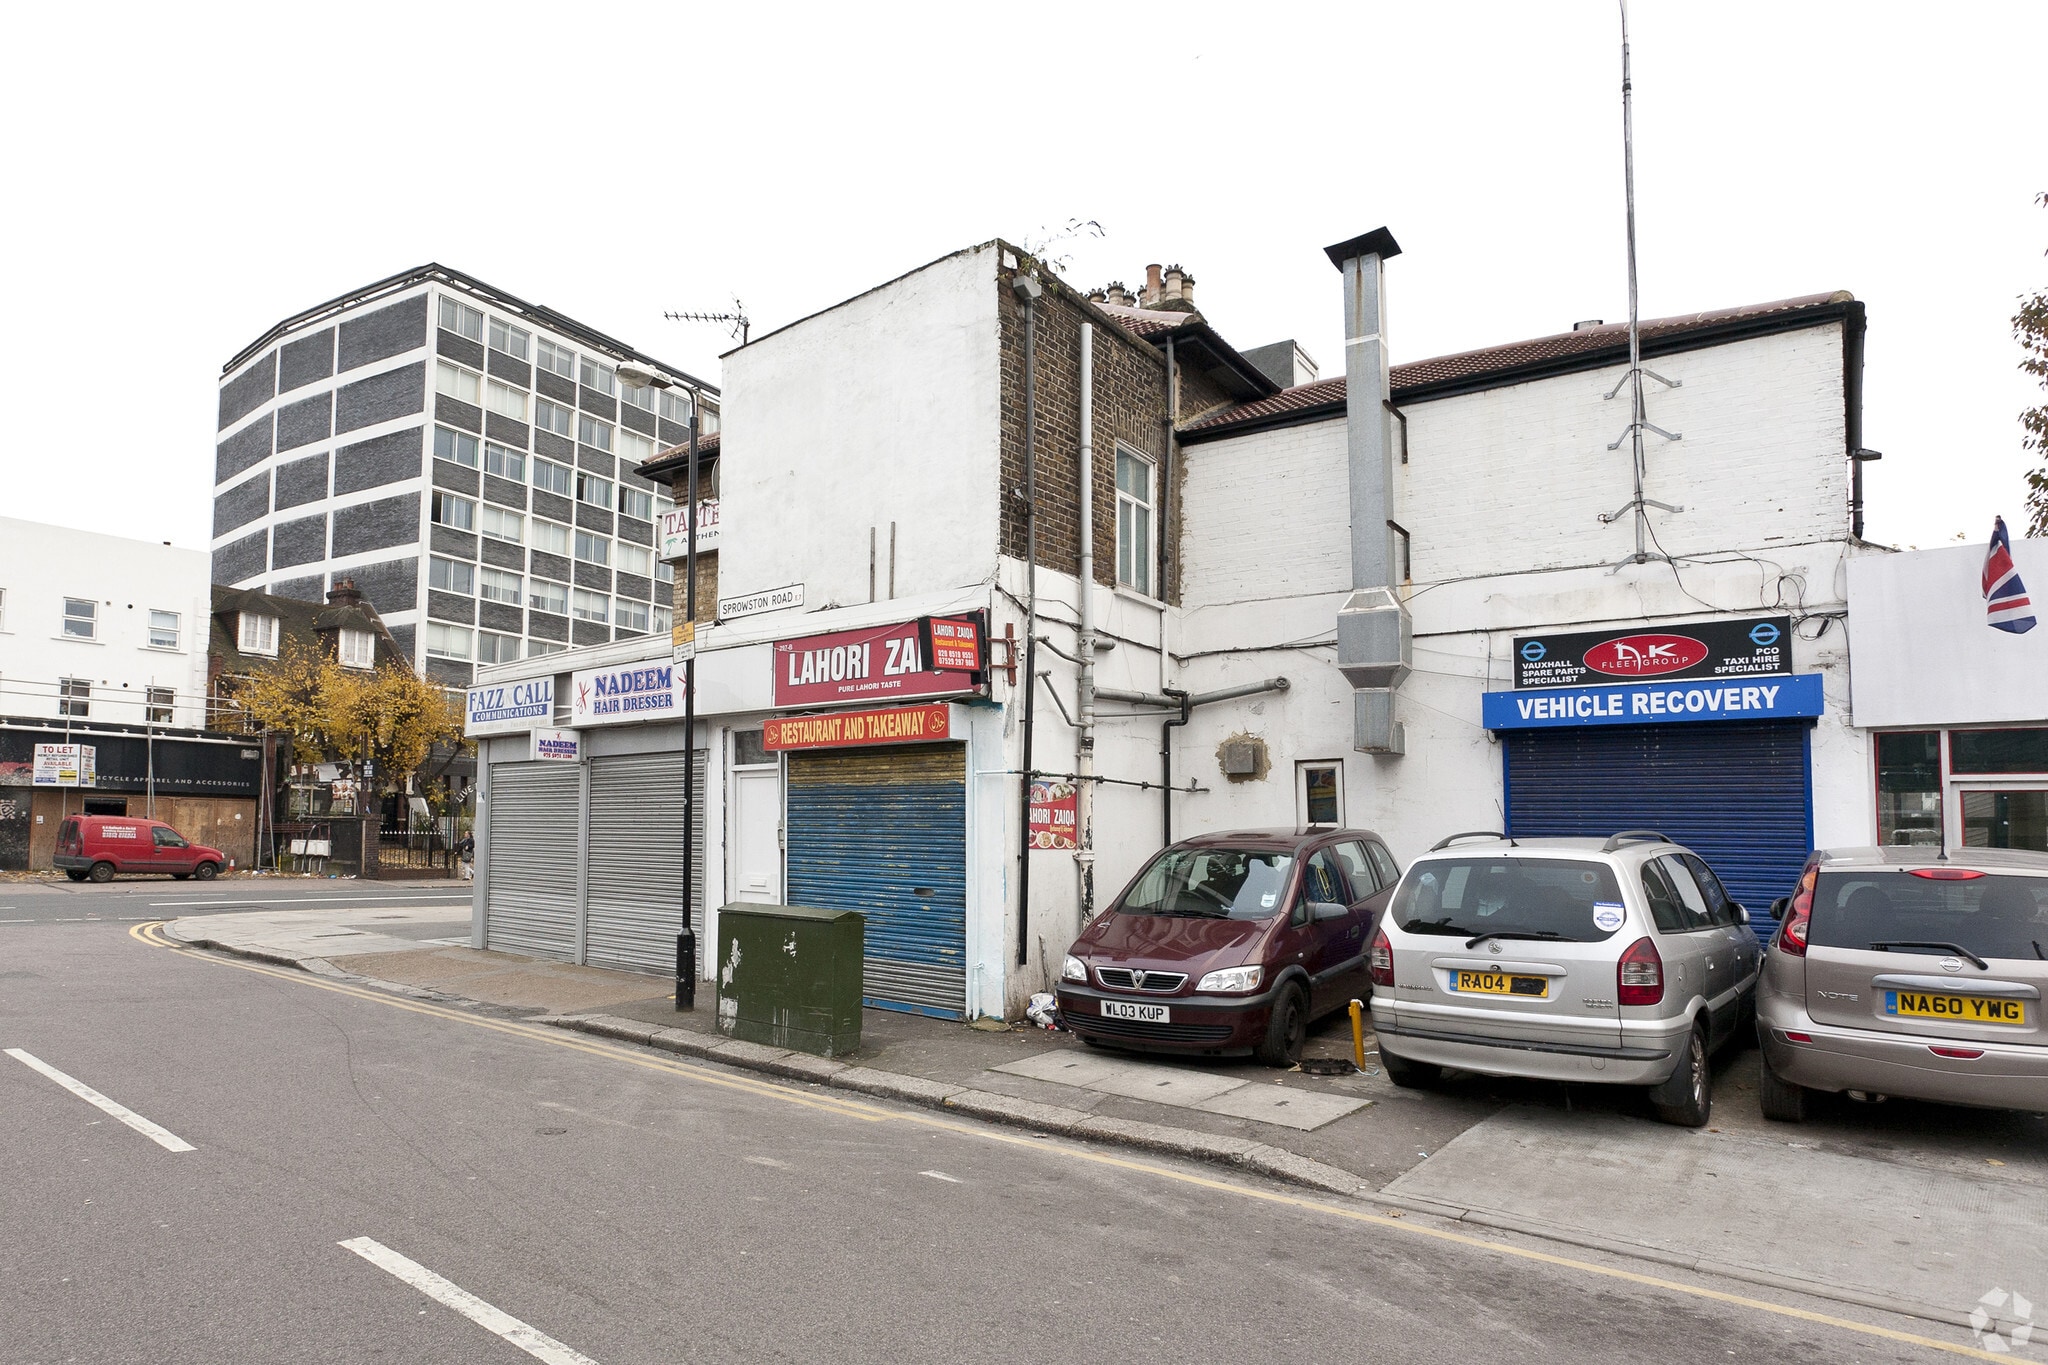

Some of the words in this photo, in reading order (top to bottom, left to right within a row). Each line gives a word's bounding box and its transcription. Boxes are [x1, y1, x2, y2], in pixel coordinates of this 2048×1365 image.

[681, 530, 719, 544] ATHEN
[722, 596, 769, 615] SPROWSTON
[771, 591, 793, 606] ROAD
[933, 623, 954, 637] LAHORI
[956, 626, 974, 640] ZAIQA
[1755, 647, 1780, 655] PCO
[788, 642, 870, 686] LAHORI
[1522, 660, 1573, 670] VAUXHALL
[1601, 659, 1638, 669] FLEET
[1642, 656, 1689, 666] GROUP
[1723, 657, 1749, 665] TAXI
[1752, 655, 1780, 663] HIRE
[1522, 669, 1553, 678] SPARE
[1555, 666, 1587, 676] PARTS
[1714, 663, 1780, 674] SPECIALIST
[594, 665, 674, 698] NADEEM
[838, 685, 855, 693] PURE
[855, 682, 880, 692] LAHORI
[880, 680, 902, 689] TASTE
[1522, 675, 1579, 685] SPECIALIST
[468, 688, 504, 712] FAZZ
[513, 680, 553, 706] CALL
[1517, 694, 1624, 720] VEHICLE
[1631, 685, 1781, 715] RECOVERY
[593, 698, 621, 715] HAIR
[622, 692, 674, 712] DRESSER
[475, 705, 544, 721] COMMUNICATIONS
[780, 718, 842, 745] RESTAURANT
[844, 716, 865, 740] AND
[866, 710, 926, 738] TAKEAWAY
[42, 746, 54, 754] TO
[57, 746, 73, 754] LET
[539, 739, 577, 749] NADEEM
[196, 780, 250, 788] ACCESSORIES
[1029, 807, 1050, 824] AHORI
[1054, 809, 1075, 826] ZAIQA
[1817, 990, 1859, 1002] NOTE
[1105, 1002, 1136, 1018] WL03
[1138, 1006, 1164, 1020] KUP
[1901, 994, 1963, 1015] NA60
[1970, 999, 2019, 1020] YWG
